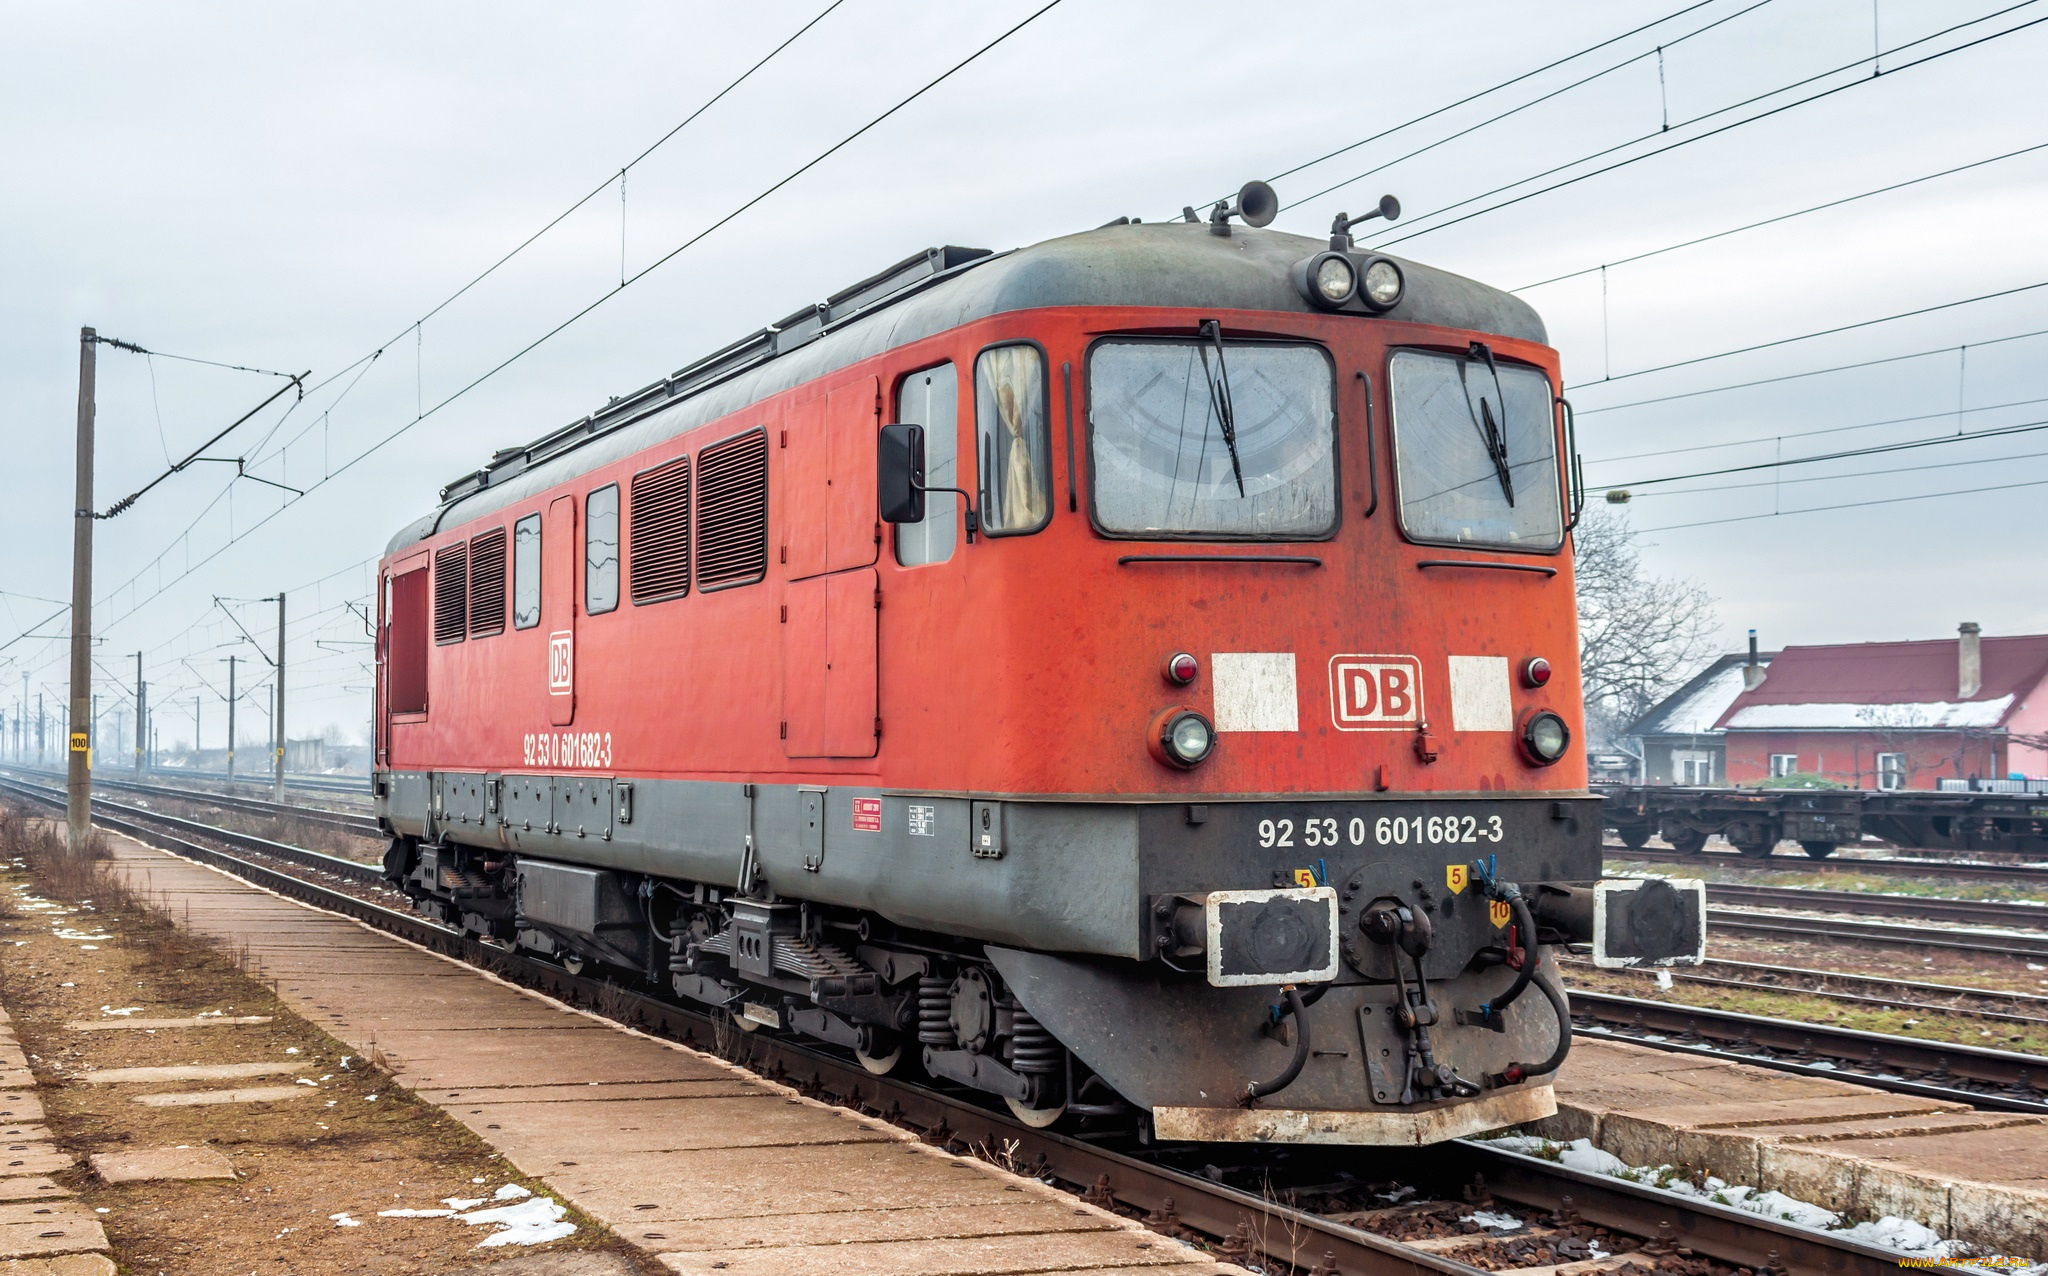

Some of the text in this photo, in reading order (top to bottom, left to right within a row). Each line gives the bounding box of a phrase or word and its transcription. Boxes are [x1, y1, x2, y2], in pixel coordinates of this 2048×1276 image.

[552, 642, 569, 683] DB
[1343, 667, 1412, 717] DB
[72, 738, 86, 748] 100
[523, 732, 612, 768] 92 53 0 601682-3
[1258, 815, 1504, 848] 92 53 0 601682-3
[1300, 872, 1311, 888] 5
[1452, 868, 1461, 885] 5
[1491, 901, 1509, 919] 10
